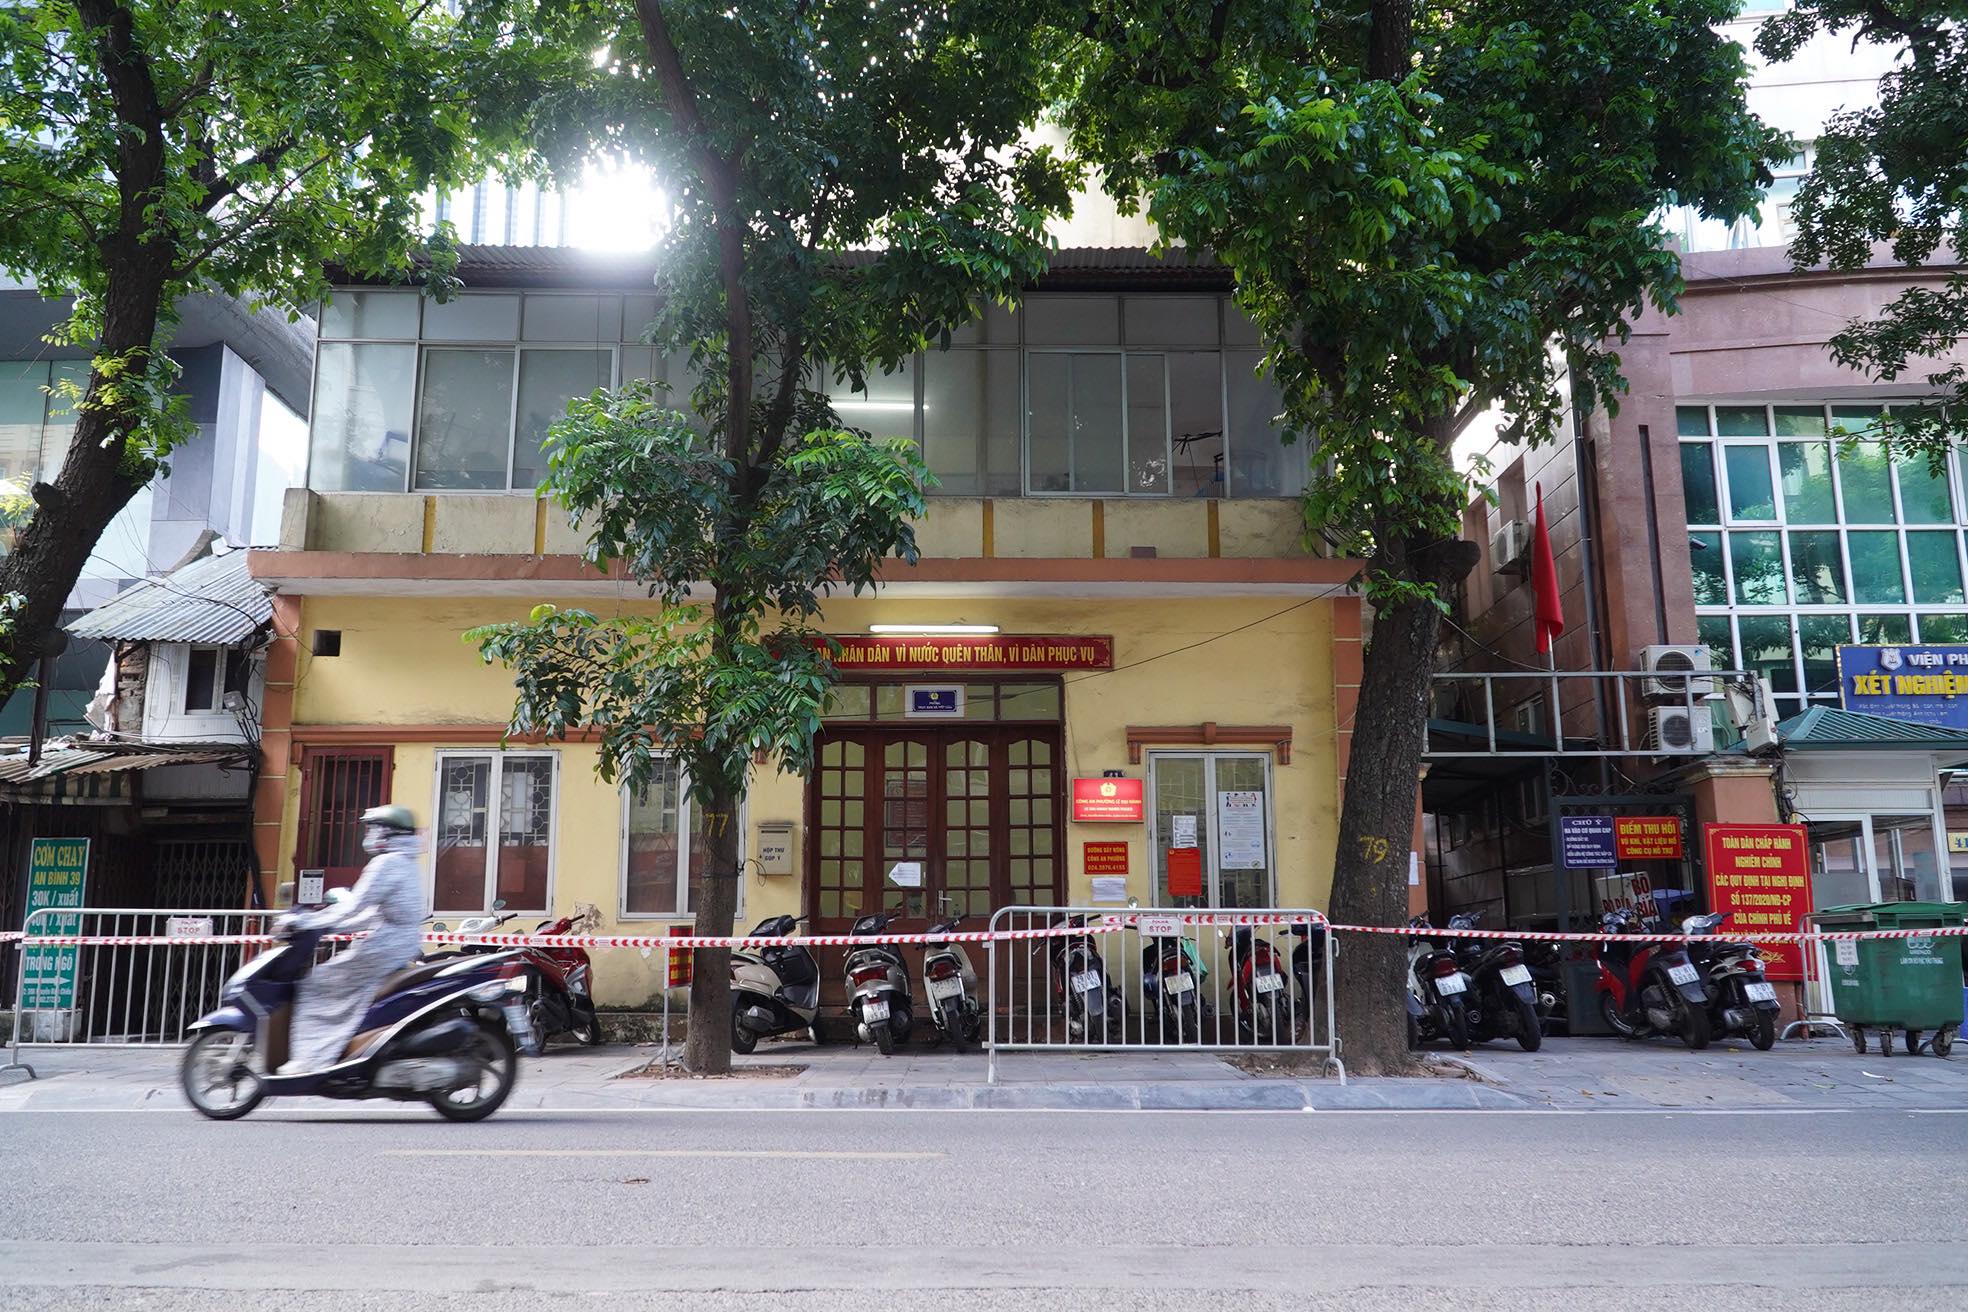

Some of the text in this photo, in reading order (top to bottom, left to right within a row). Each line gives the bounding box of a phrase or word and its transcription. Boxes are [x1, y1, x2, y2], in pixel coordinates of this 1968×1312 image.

[867, 644, 889, 662] DÂN
[896, 643, 906, 662] VÌ
[909, 642, 939, 662] NƯỚC
[942, 644, 972, 663] QUÊN
[974, 644, 1006, 664] THÂN,
[1008, 643, 1020, 662] VÌ
[1023, 644, 1044, 662] DÂN
[1048, 646, 1077, 664] PHỤC
[1080, 646, 1094, 664] VỤ
[1907, 651, 1944, 669] VIỆN
[1853, 669, 1892, 695] XÉT
[704, 813, 729, 837] 77
[1643, 824, 1660, 835] THU
[1360, 835, 1389, 865] 79
[1722, 834, 1792, 850] TOÀN DÂN CHẤP HÀNH
[57, 846, 86, 867] CHAY
[1735, 852, 1782, 868] NGHIÊM CHỈNH
[33, 868, 81, 886] AN BÌNH 39
[1715, 873, 1805, 890] CÁC QUY ĐỊNH TẠI NGHỊ ĐỊNH
[31, 890, 50, 906] 30K
[57, 887, 80, 906] xuất
[1730, 889, 1741, 906] SỐ
[1734, 908, 1748, 925] CỦA
[1748, 910, 1768, 925] CHÍNH
[1769, 909, 1782, 925] PHỦ
